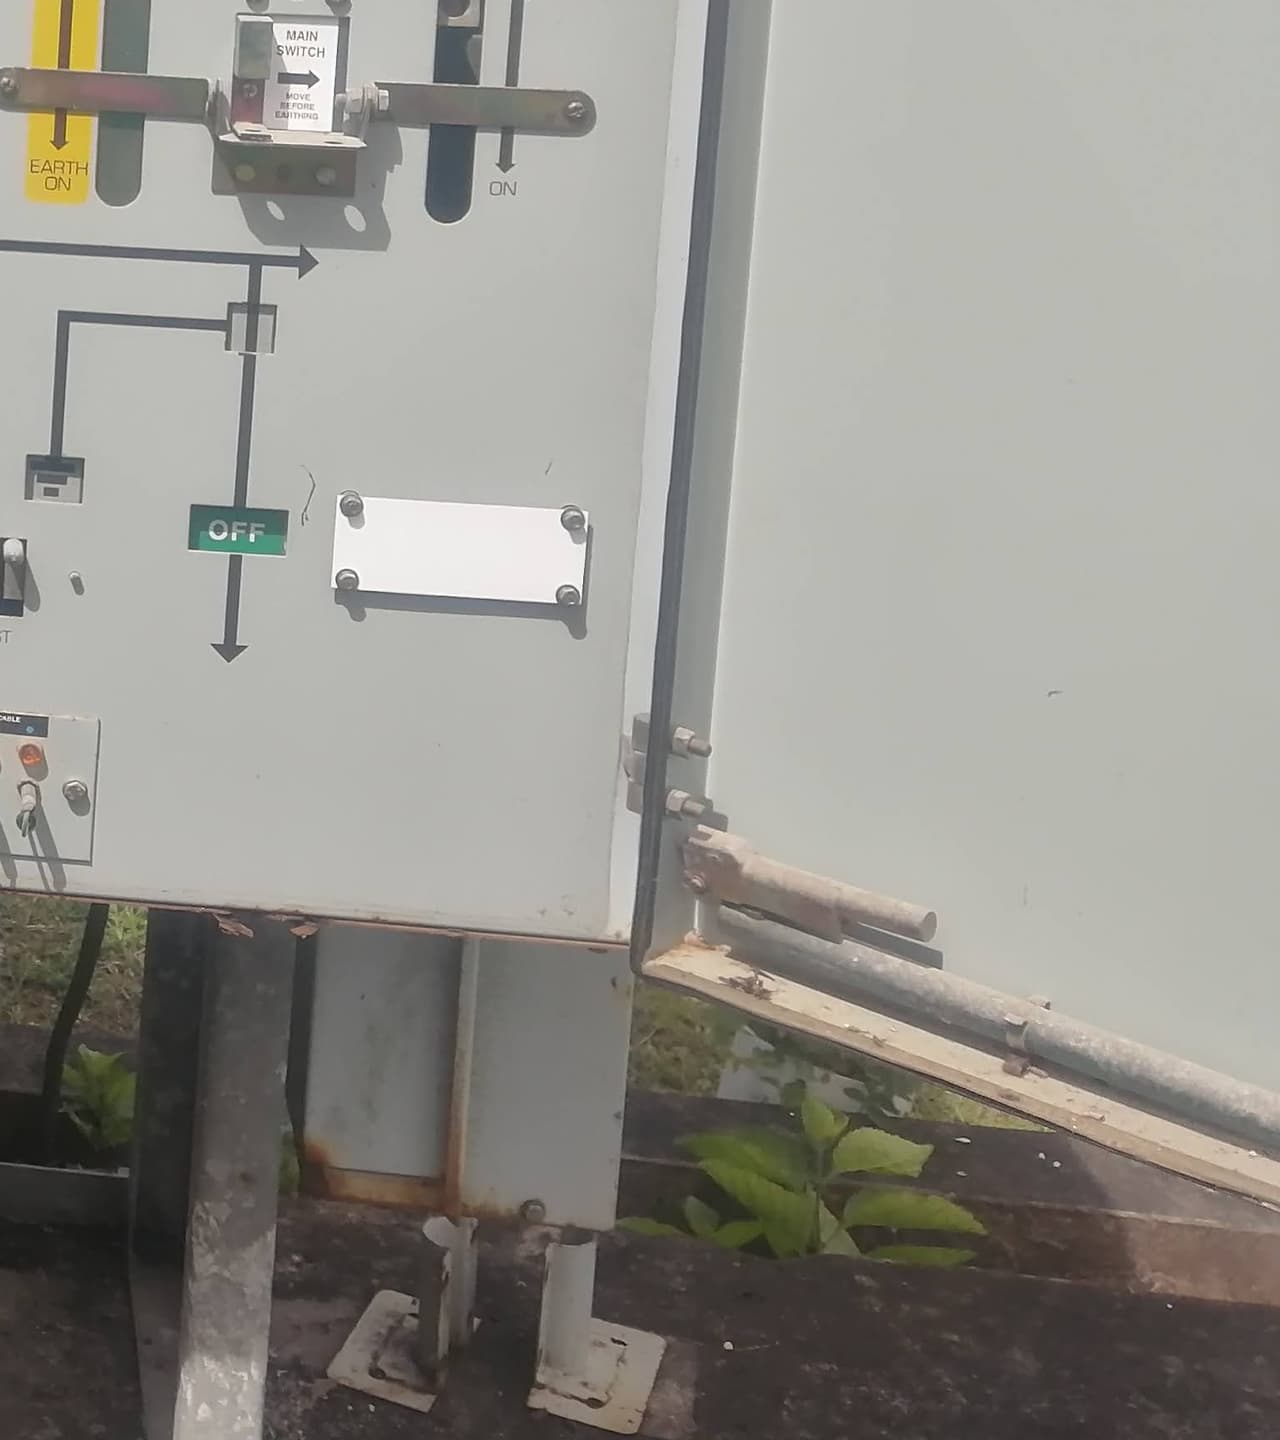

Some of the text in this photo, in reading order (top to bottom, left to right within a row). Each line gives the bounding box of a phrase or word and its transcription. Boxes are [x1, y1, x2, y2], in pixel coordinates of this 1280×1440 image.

[286, 30, 319, 42] MAIN
[276, 44, 326, 58] SWITCH
[286, 92, 311, 101] MOVE
[280, 102, 315, 111] BEFORE
[29, 159, 90, 176] EARTH
[44, 176, 72, 192] ON
[489, 181, 518, 197] ON
[208, 519, 266, 543] OFF
